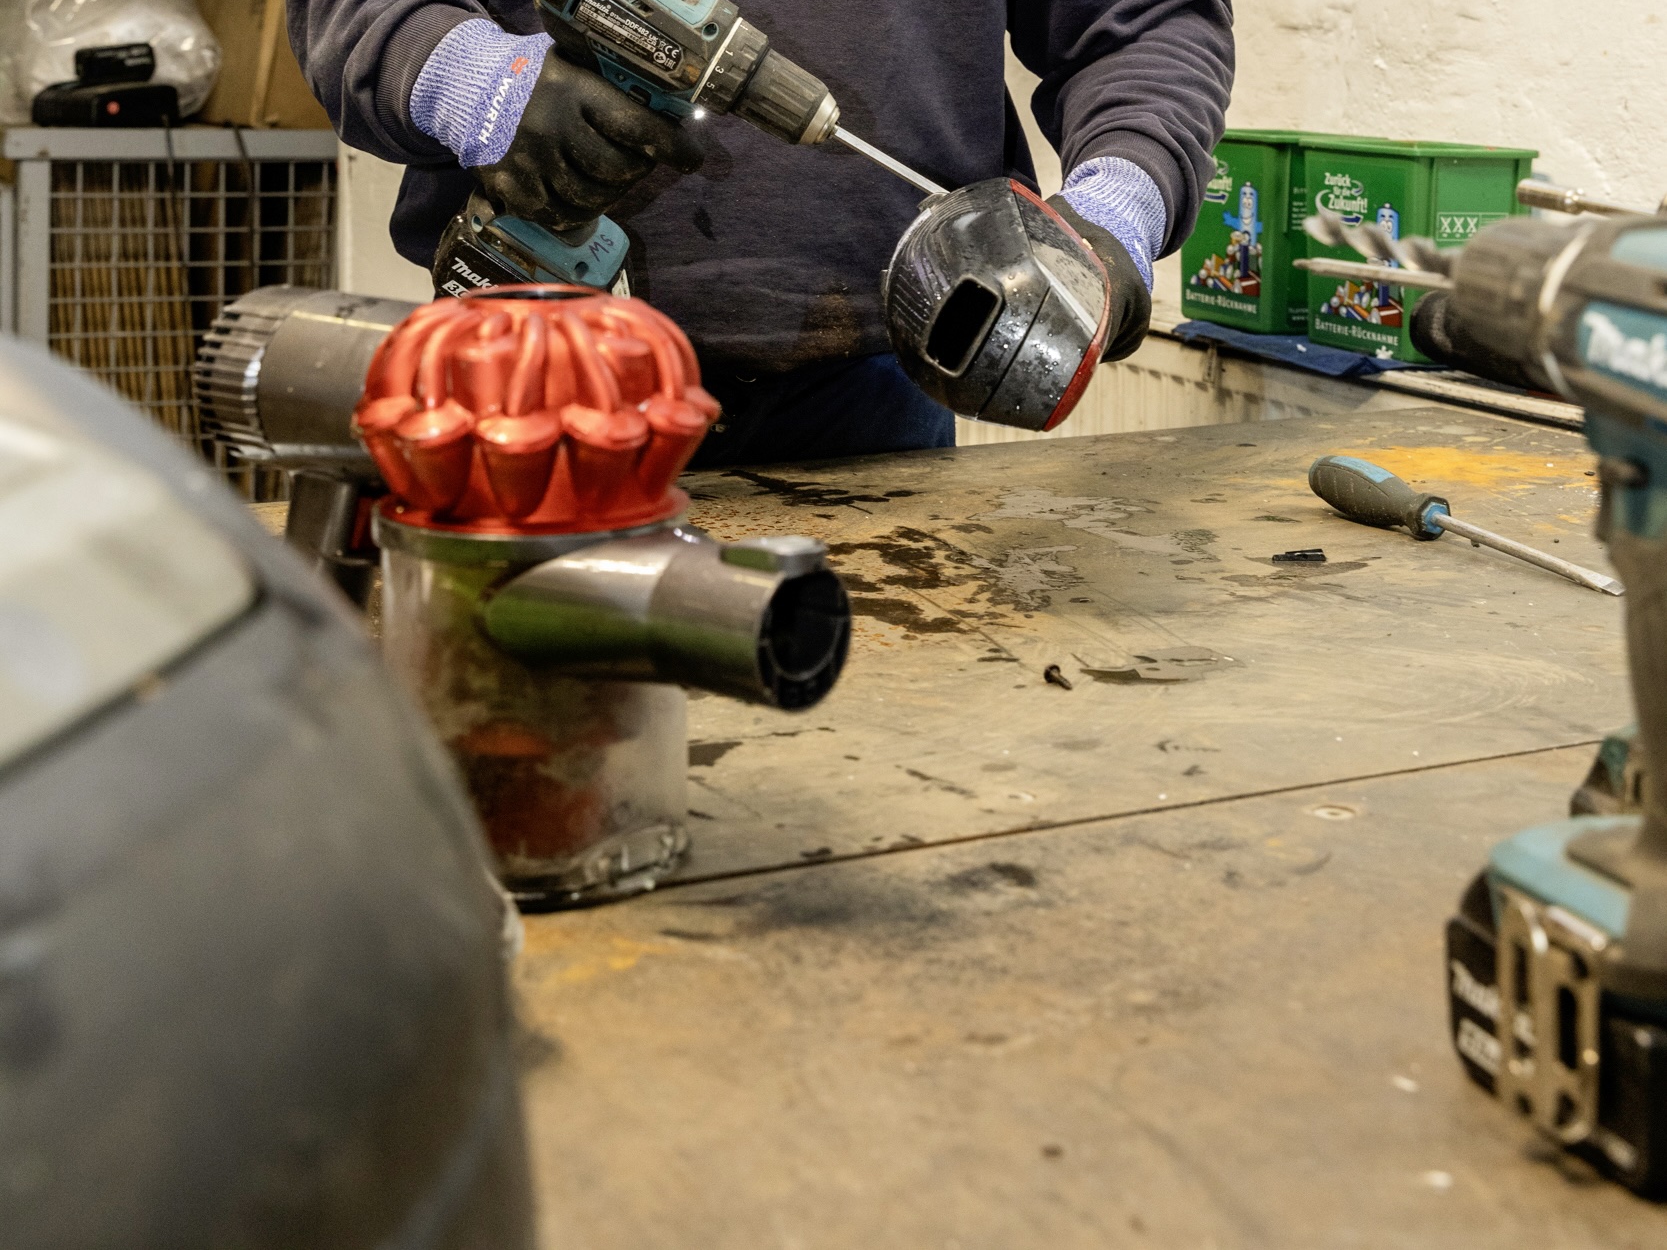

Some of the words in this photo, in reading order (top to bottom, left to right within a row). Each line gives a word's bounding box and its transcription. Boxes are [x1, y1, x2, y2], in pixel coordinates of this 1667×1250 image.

[625, 19, 649, 37] DDF482
[715, 65, 724, 74] 3
[1324, 172, 1351, 187] Zurück
[1328, 194, 1368, 213] Zukunft!
[1315, 317, 1399, 346] BATTERIE-RÜCKNAHME
